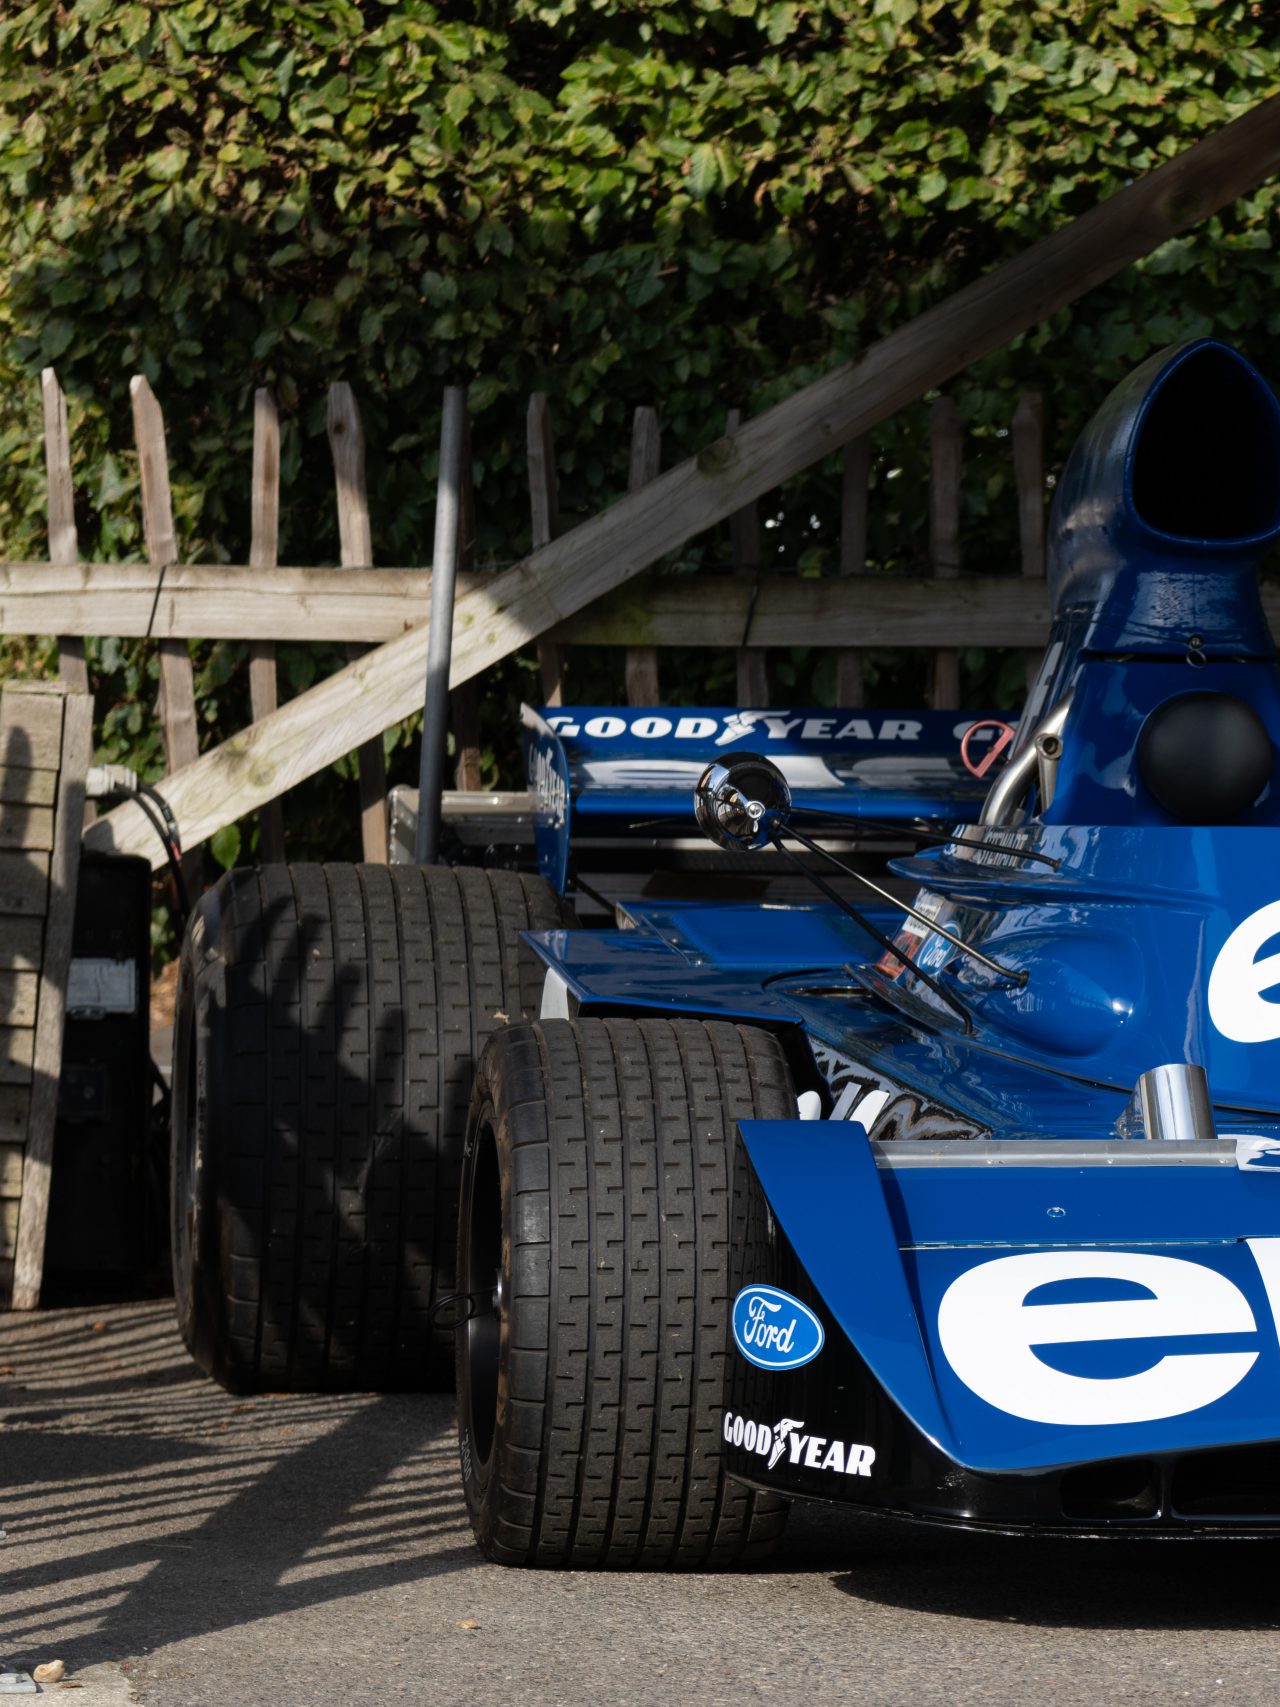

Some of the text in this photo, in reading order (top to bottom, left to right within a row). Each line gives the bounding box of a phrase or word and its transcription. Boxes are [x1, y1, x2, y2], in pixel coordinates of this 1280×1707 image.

[547, 712, 923, 745] GOODYEAR
[743, 1296, 796, 1354] Ford
[724, 1411, 877, 1478] GOODYEAR
